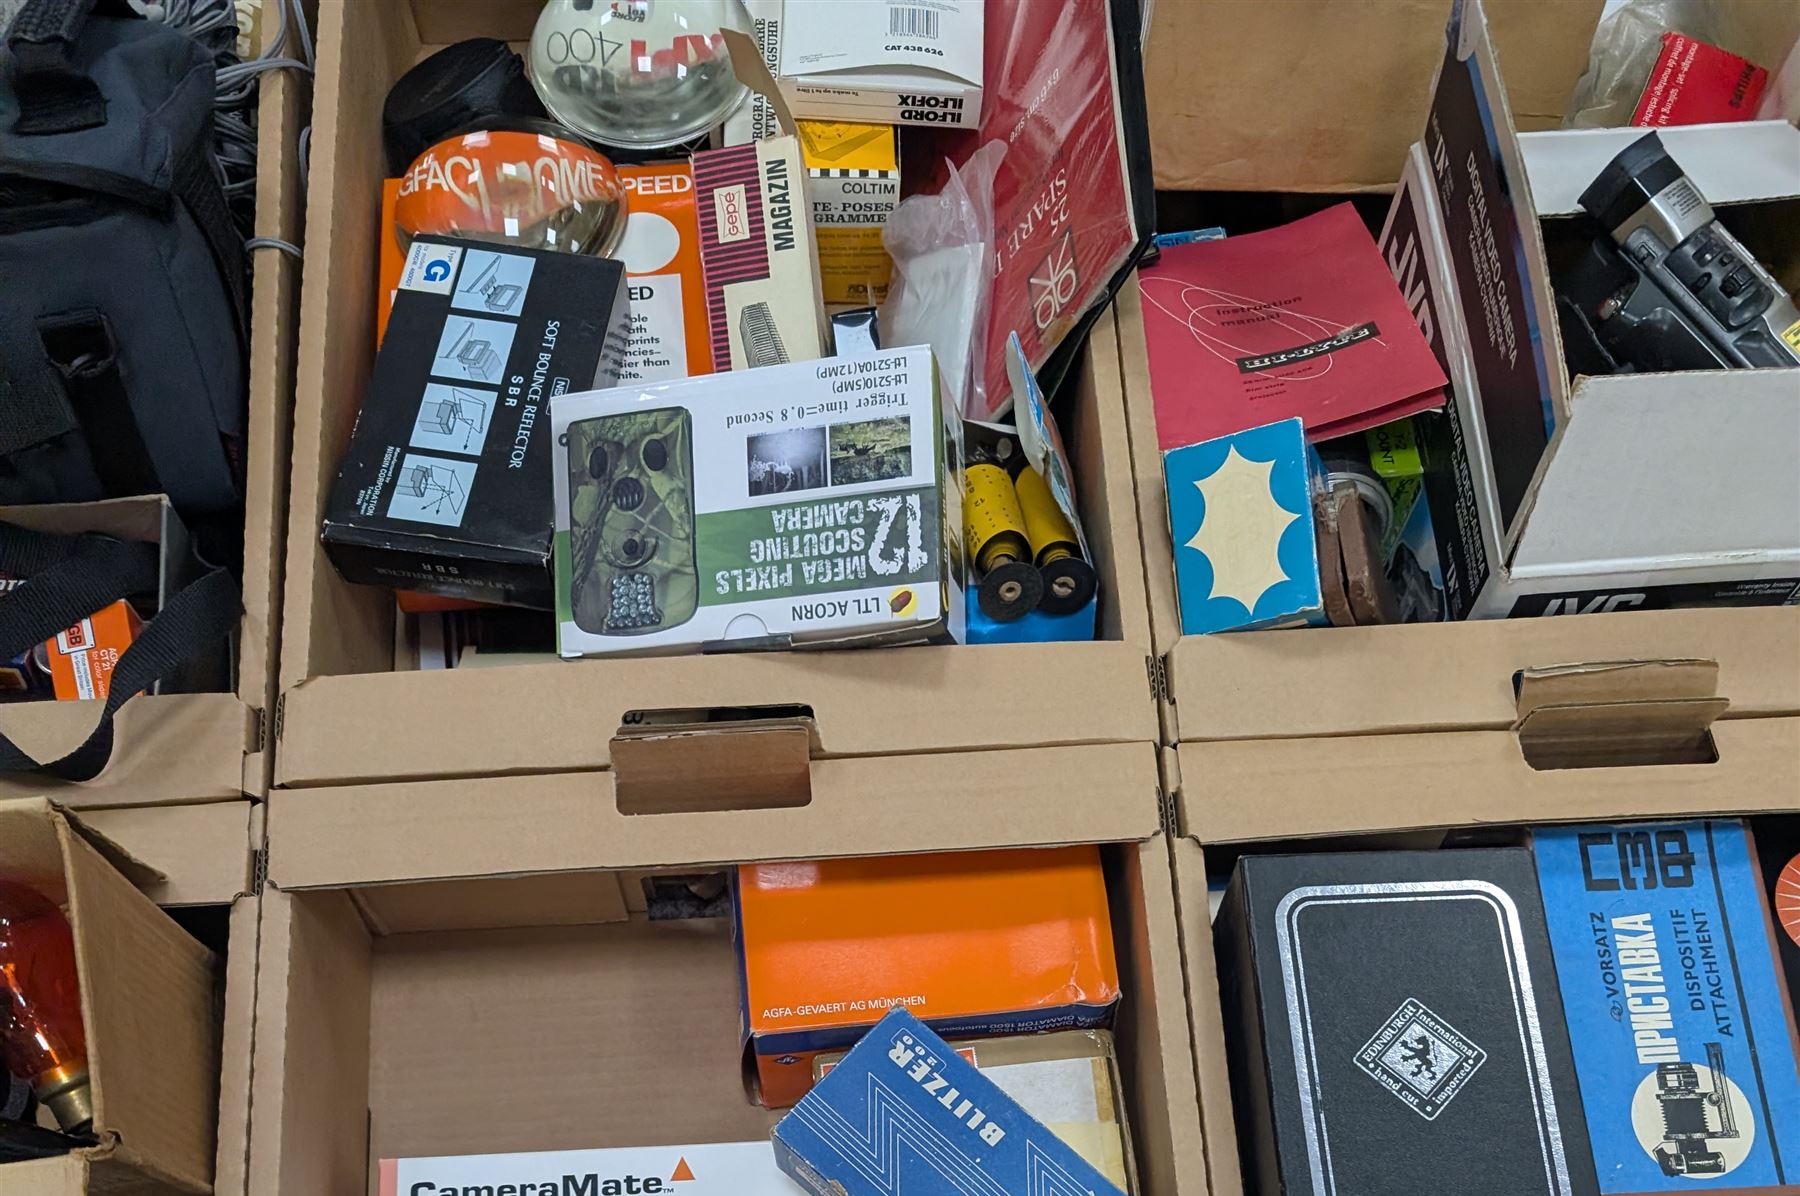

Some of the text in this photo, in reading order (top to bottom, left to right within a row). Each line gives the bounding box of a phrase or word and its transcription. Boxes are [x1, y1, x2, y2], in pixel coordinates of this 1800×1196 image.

[547, 28, 623, 66] 400
[924, 47, 944, 56] 626
[897, 94, 964, 110] ILFOFIX
[900, 109, 962, 124] ILFORD
[765, 159, 796, 252] MAGAZIN
[841, 182, 896, 195] COLTIM
[1008, 168, 1067, 259] SPARE
[1051, 194, 1070, 237] 25
[423, 259, 451, 282] G
[1466, 150, 1518, 370] DIGITAL VIDEO CAMERA
[643, 356, 670, 367] than
[508, 320, 560, 469] SOFT BOUNCE REFLECTOR
[726, 392, 909, 429] Trigger Second
[366, 445, 394, 516] NISSIN CORPORATION
[1447, 398, 1486, 579] DIGITAL VIDEO CAMERA
[771, 499, 865, 533] CAMERA
[866, 493, 929, 576] 12
[750, 527, 866, 563] SCOUTING
[715, 555, 867, 595] MEGA PIXELS
[791, 597, 880, 621] LTL ACORN
[67, 625, 83, 646] GB
[1589, 911, 1620, 999] VORSATZ
[1670, 909, 1705, 1012] DISPOSITIF
[1691, 908, 1734, 1038] ATTACHMENT
[762, 995, 926, 1019] AGFA-GEVAERT AG MÜNCHEN
[1611, 912, 1681, 1065] ПРИСТАВКА
[1017, 1015, 1075, 1027] DIAMATOR
[1361, 1004, 1478, 1062] EDINBURGH International
[888, 1041, 1006, 1147] BLITZER
[1374, 1061, 1472, 1106] hand cut imported
